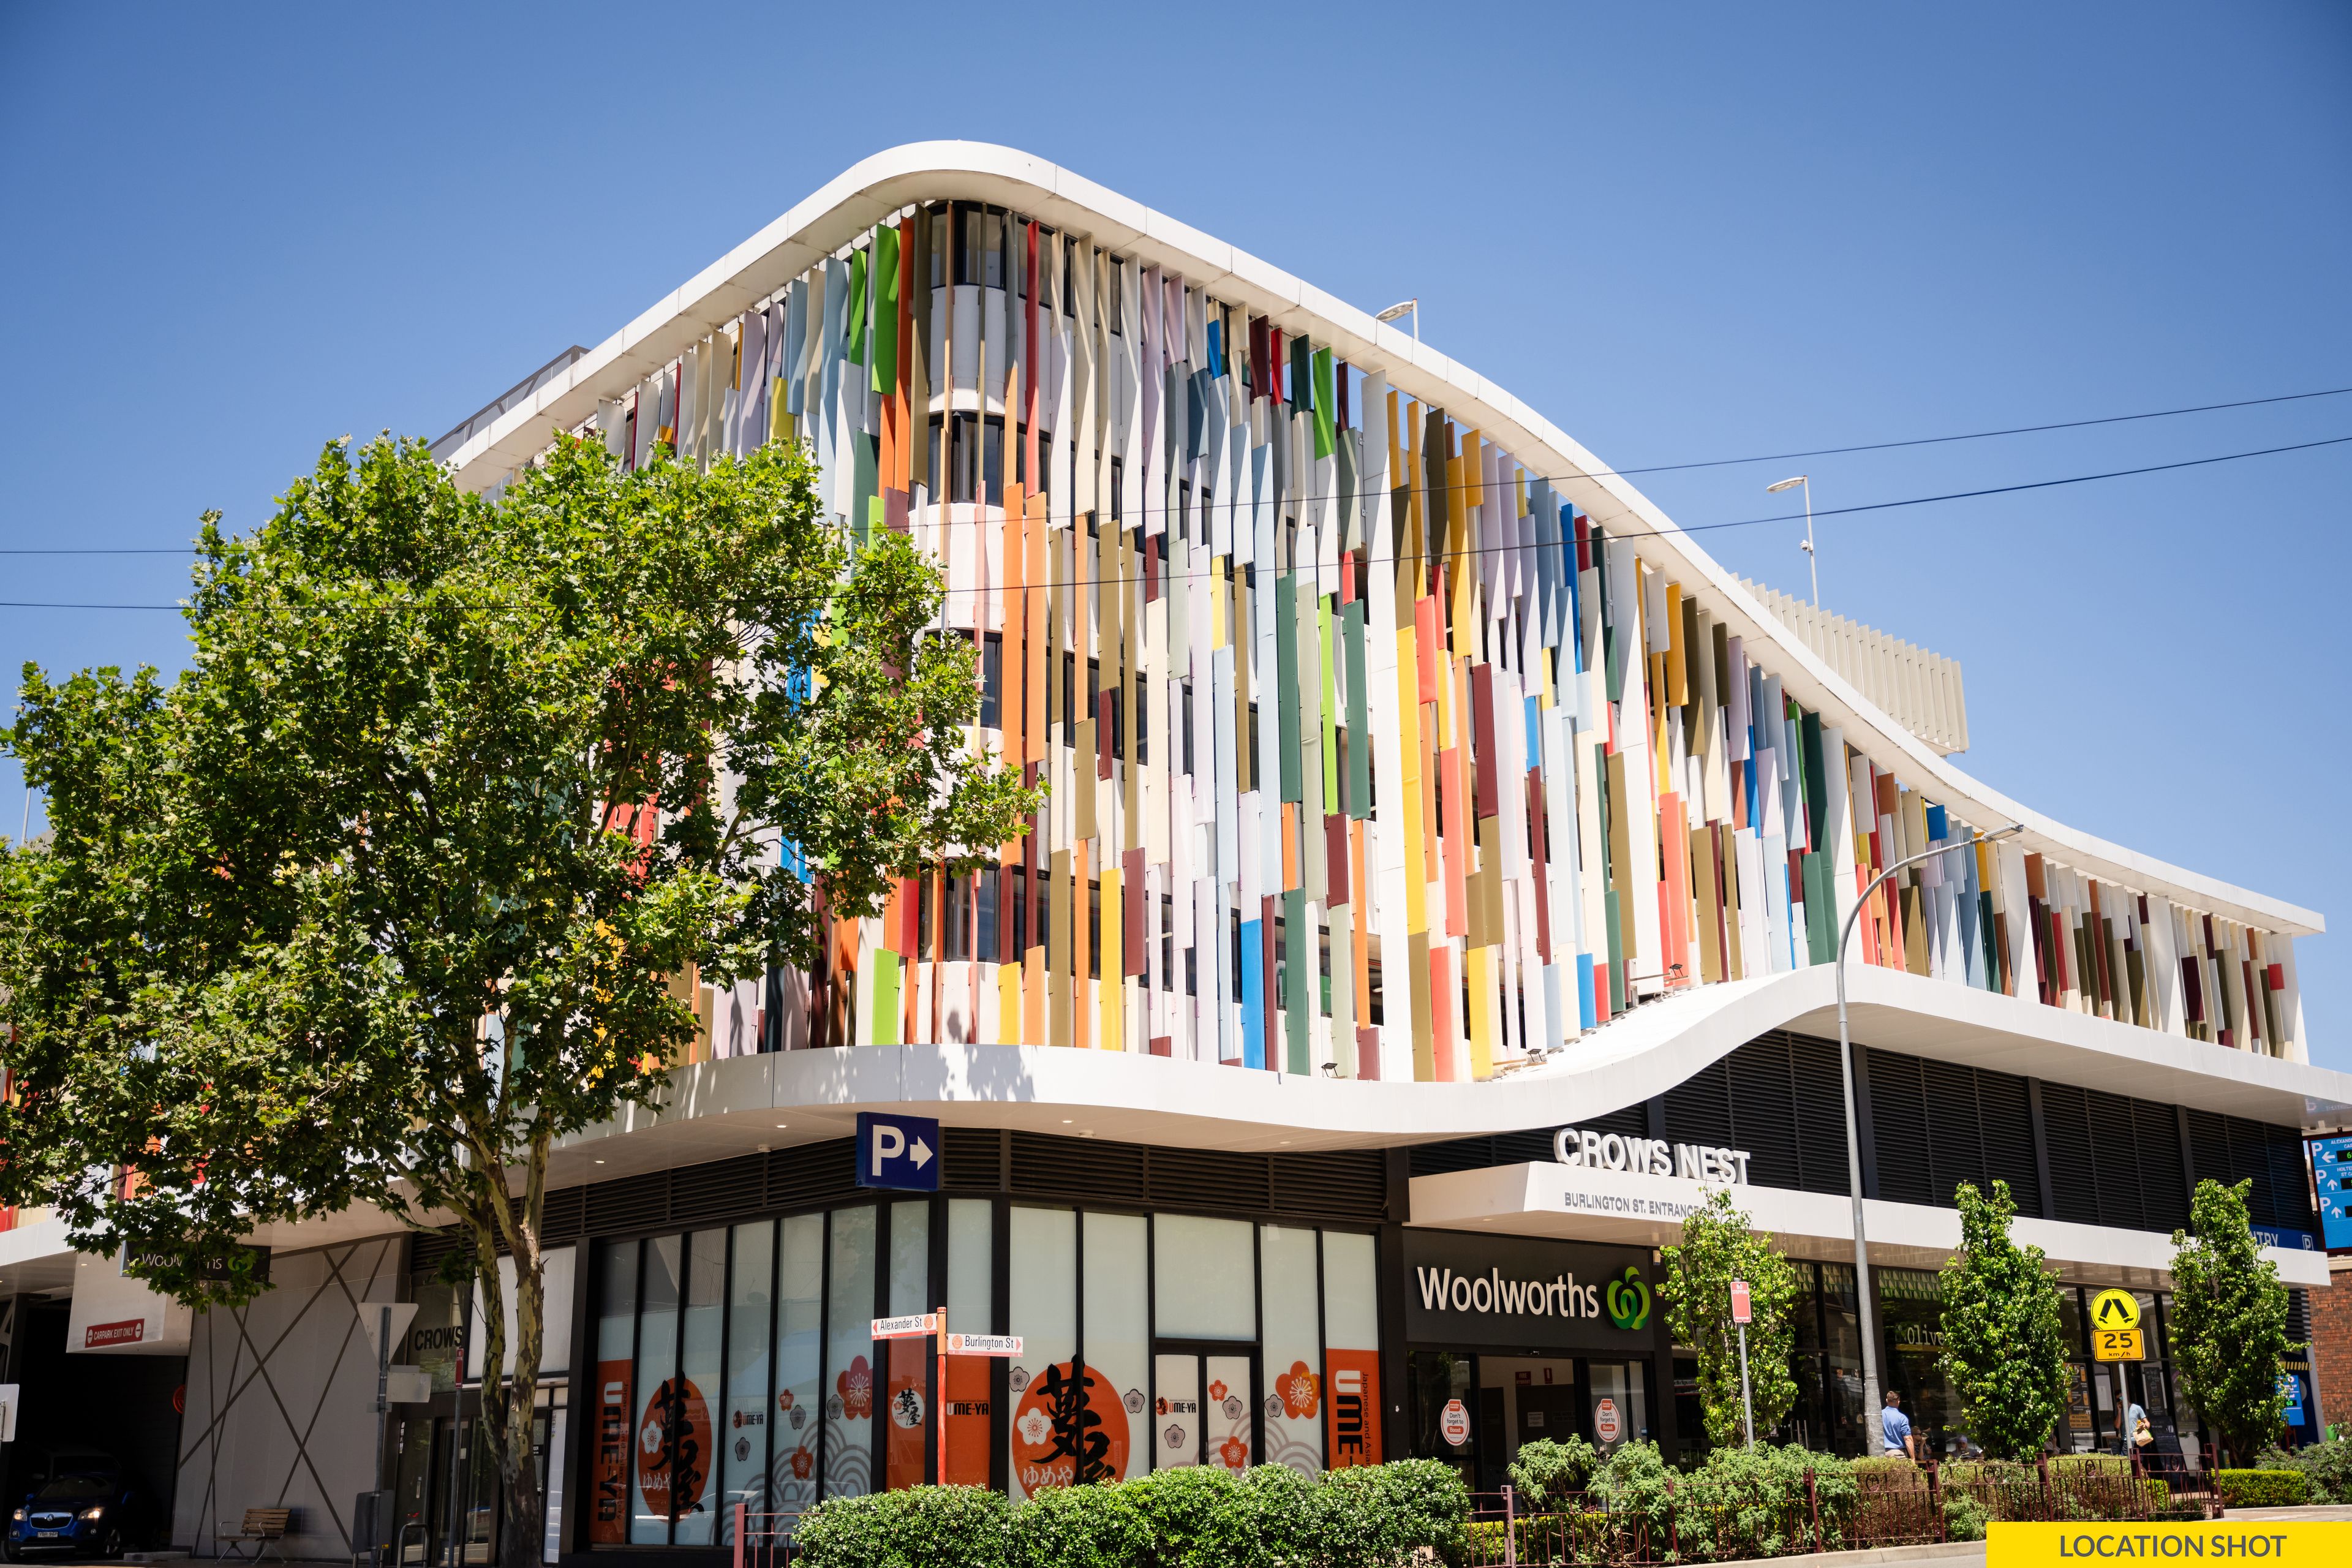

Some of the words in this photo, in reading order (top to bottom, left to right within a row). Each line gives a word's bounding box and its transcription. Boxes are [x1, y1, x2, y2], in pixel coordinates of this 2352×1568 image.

[872, 1125, 905, 1176] P
[1555, 1128, 1672, 1176] CROWS
[1675, 1143, 1751, 1185] NEST
[2312, 1142, 2323, 1156] P
[2315, 1170, 2327, 1184] P
[1565, 1192, 1629, 1212] BURLINGTON
[1632, 1199, 1646, 1213] ST.
[2319, 1197, 2331, 1212] P
[1417, 1266, 1599, 1318] Woolworths
[880, 1318, 912, 1330] Alexander
[914, 1316, 922, 1327] St
[94, 1330, 113, 1340] CARPARK
[114, 1328, 123, 1338] EXIT
[123, 1327, 134, 1336] ONLY
[415, 1326, 462, 1351] CROWS
[2103, 1333, 2133, 1349] 25
[965, 1335, 1003, 1350] Burlington
[1005, 1337, 1014, 1348] St
[947, 1403, 989, 1415] UME-YA
[1169, 1403, 1196, 1413] UME-YA
[743, 1414, 763, 1425] UME-YA
[1335, 1370, 1363, 1467] UME-
[598, 1381, 623, 1521] UME-YA
[1023, 1466, 1073, 1487] ゆめや
